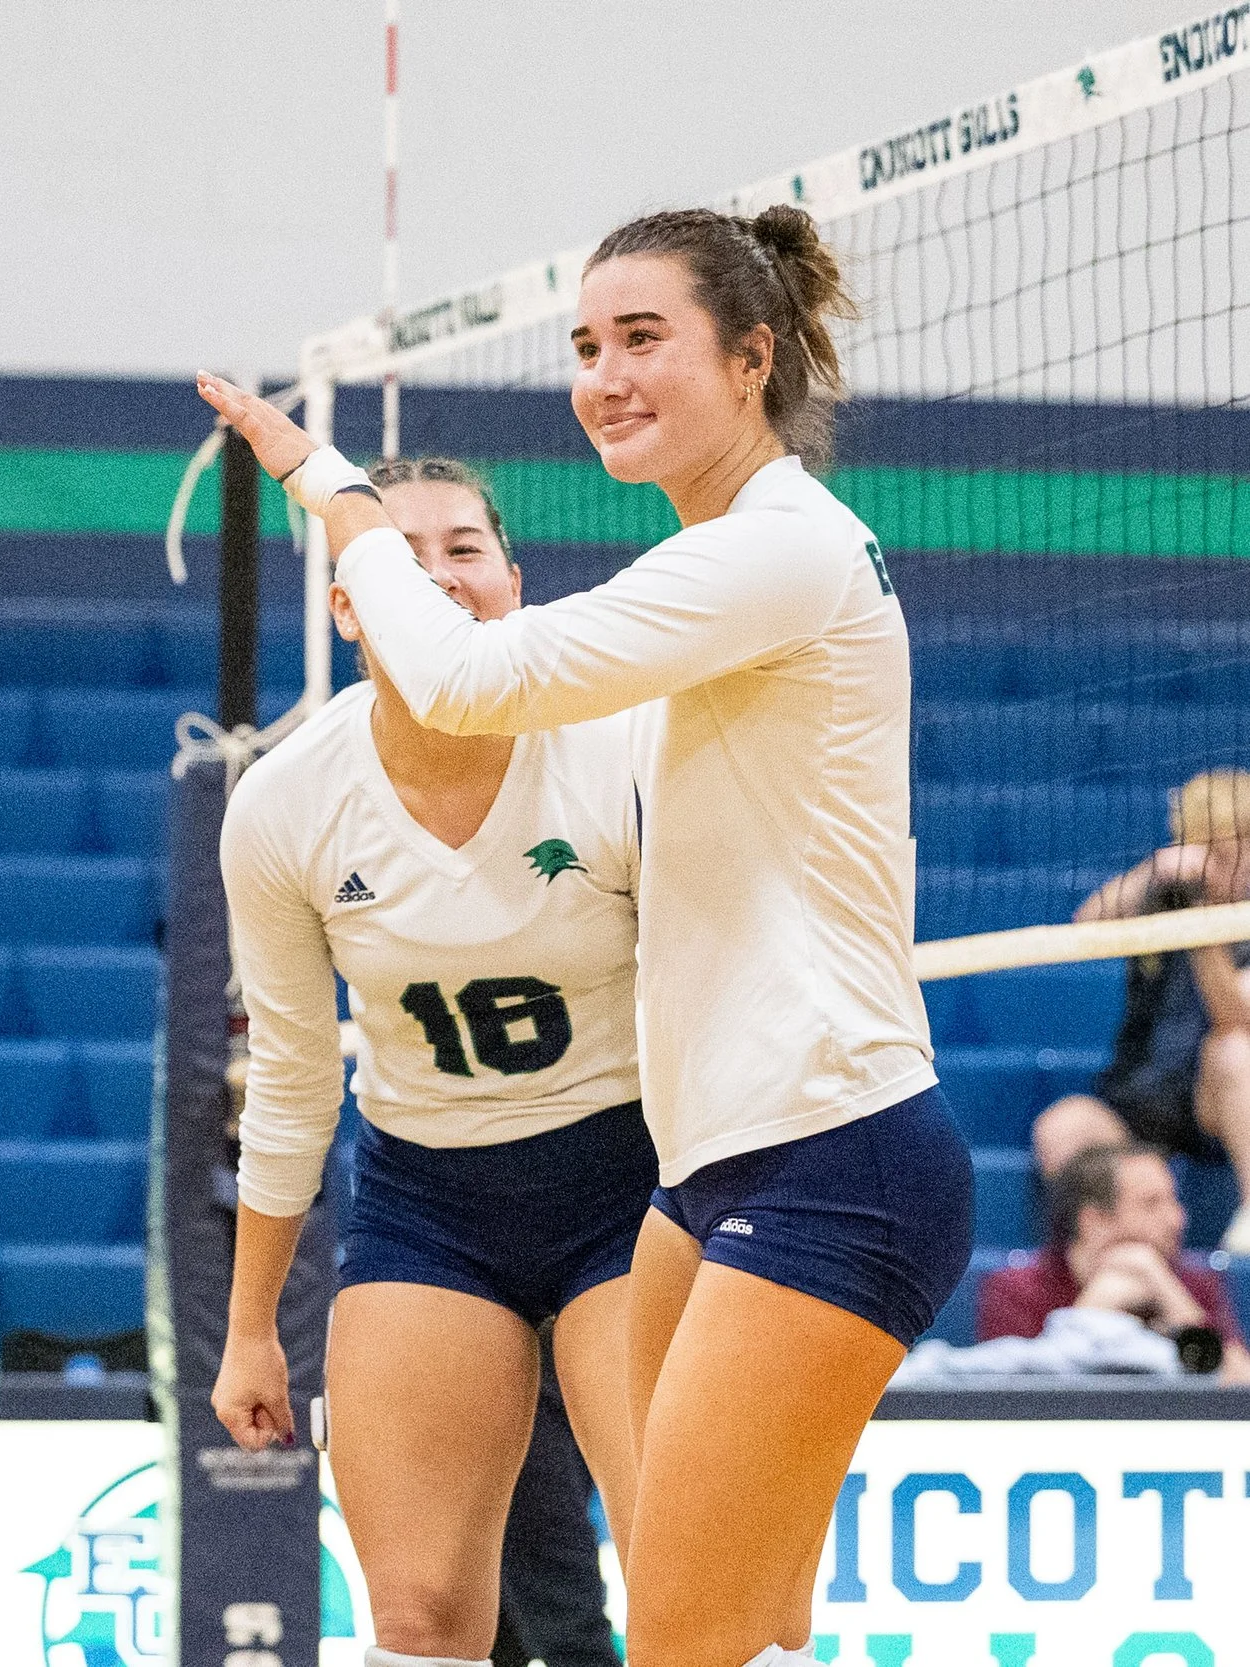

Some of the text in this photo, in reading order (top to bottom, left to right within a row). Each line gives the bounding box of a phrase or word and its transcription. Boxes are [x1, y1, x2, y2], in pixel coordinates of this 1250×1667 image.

[334, 891, 376, 903] adidas
[399, 975, 573, 1079] 16
[720, 1218, 754, 1235] adidas
[826, 1470, 1250, 1603] ICOT
